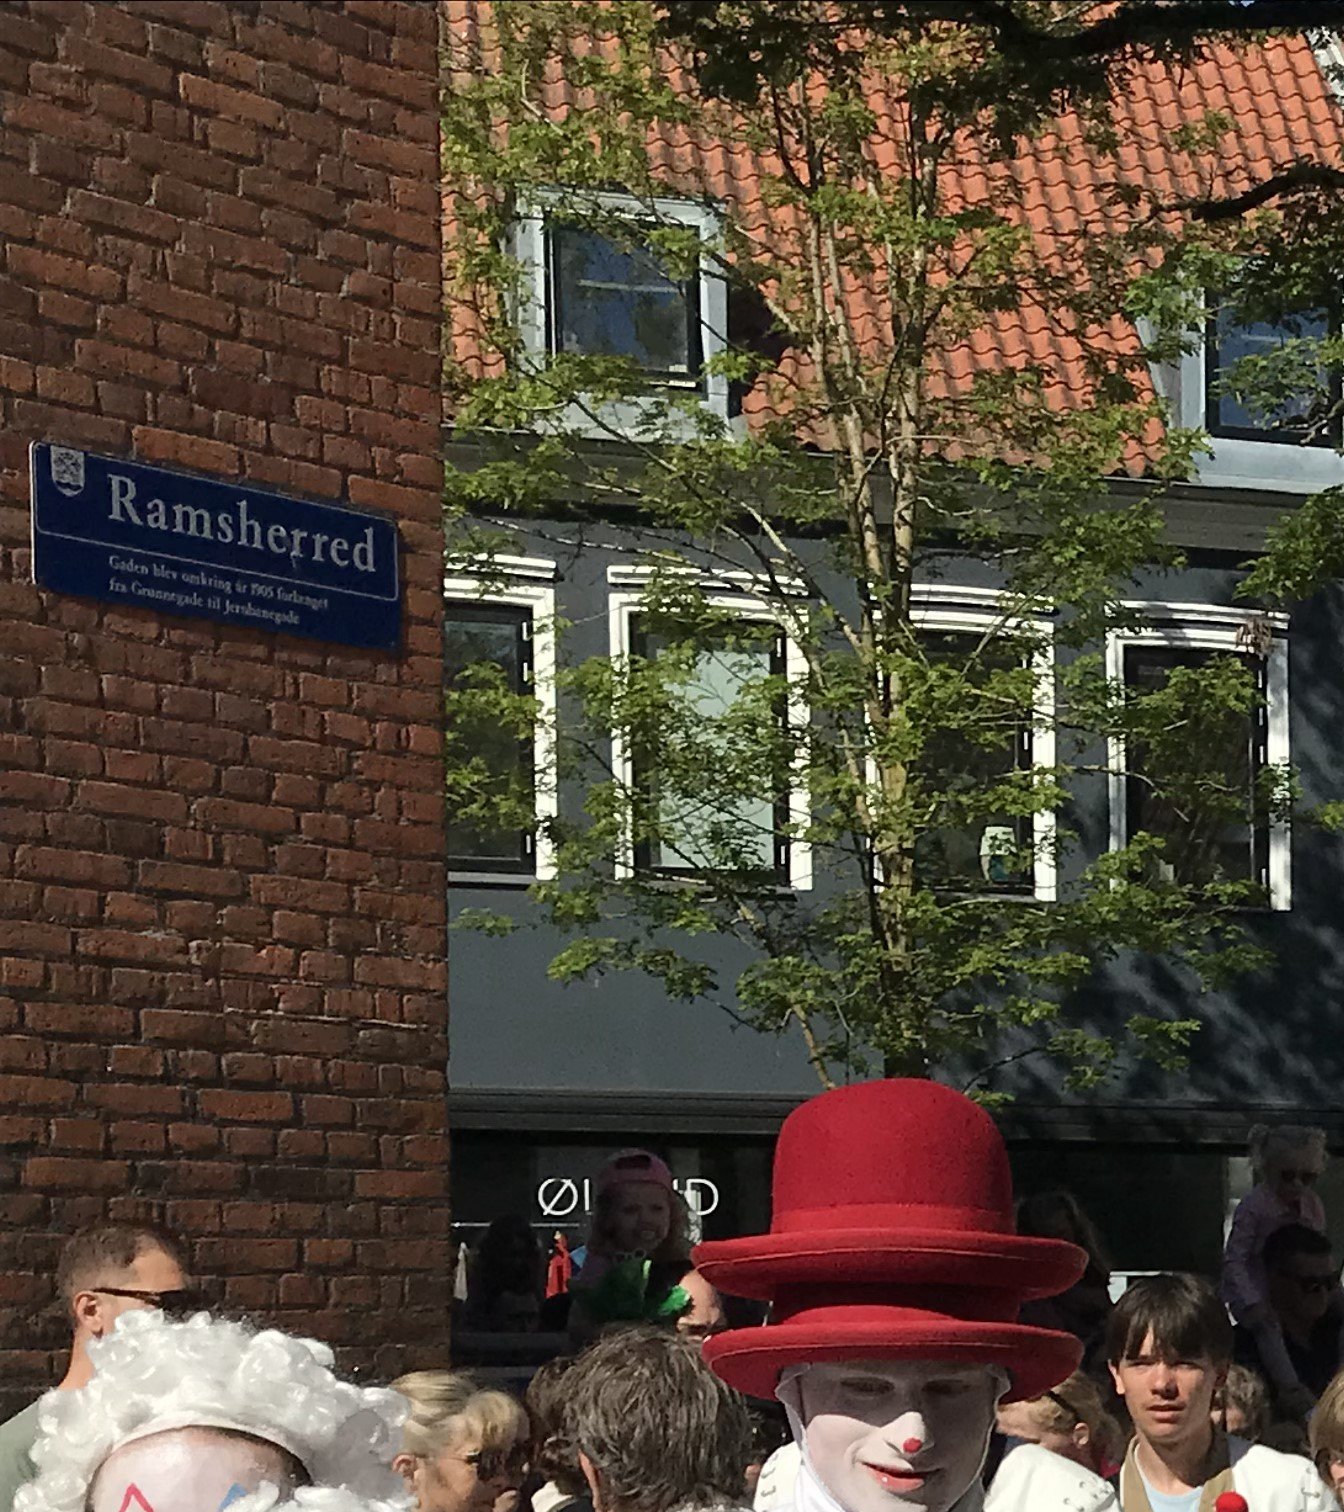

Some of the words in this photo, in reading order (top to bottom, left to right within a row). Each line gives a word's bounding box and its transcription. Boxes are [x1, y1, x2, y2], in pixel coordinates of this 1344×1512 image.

[107, 473, 376, 573] Ramsherred
[109, 555, 148, 574] Gaden
[153, 563, 177, 579] blev
[182, 572, 232, 594] omkring
[109, 577, 127, 593] fra
[207, 597, 220, 609] til
[537, 1178, 719, 1217] ØLD
